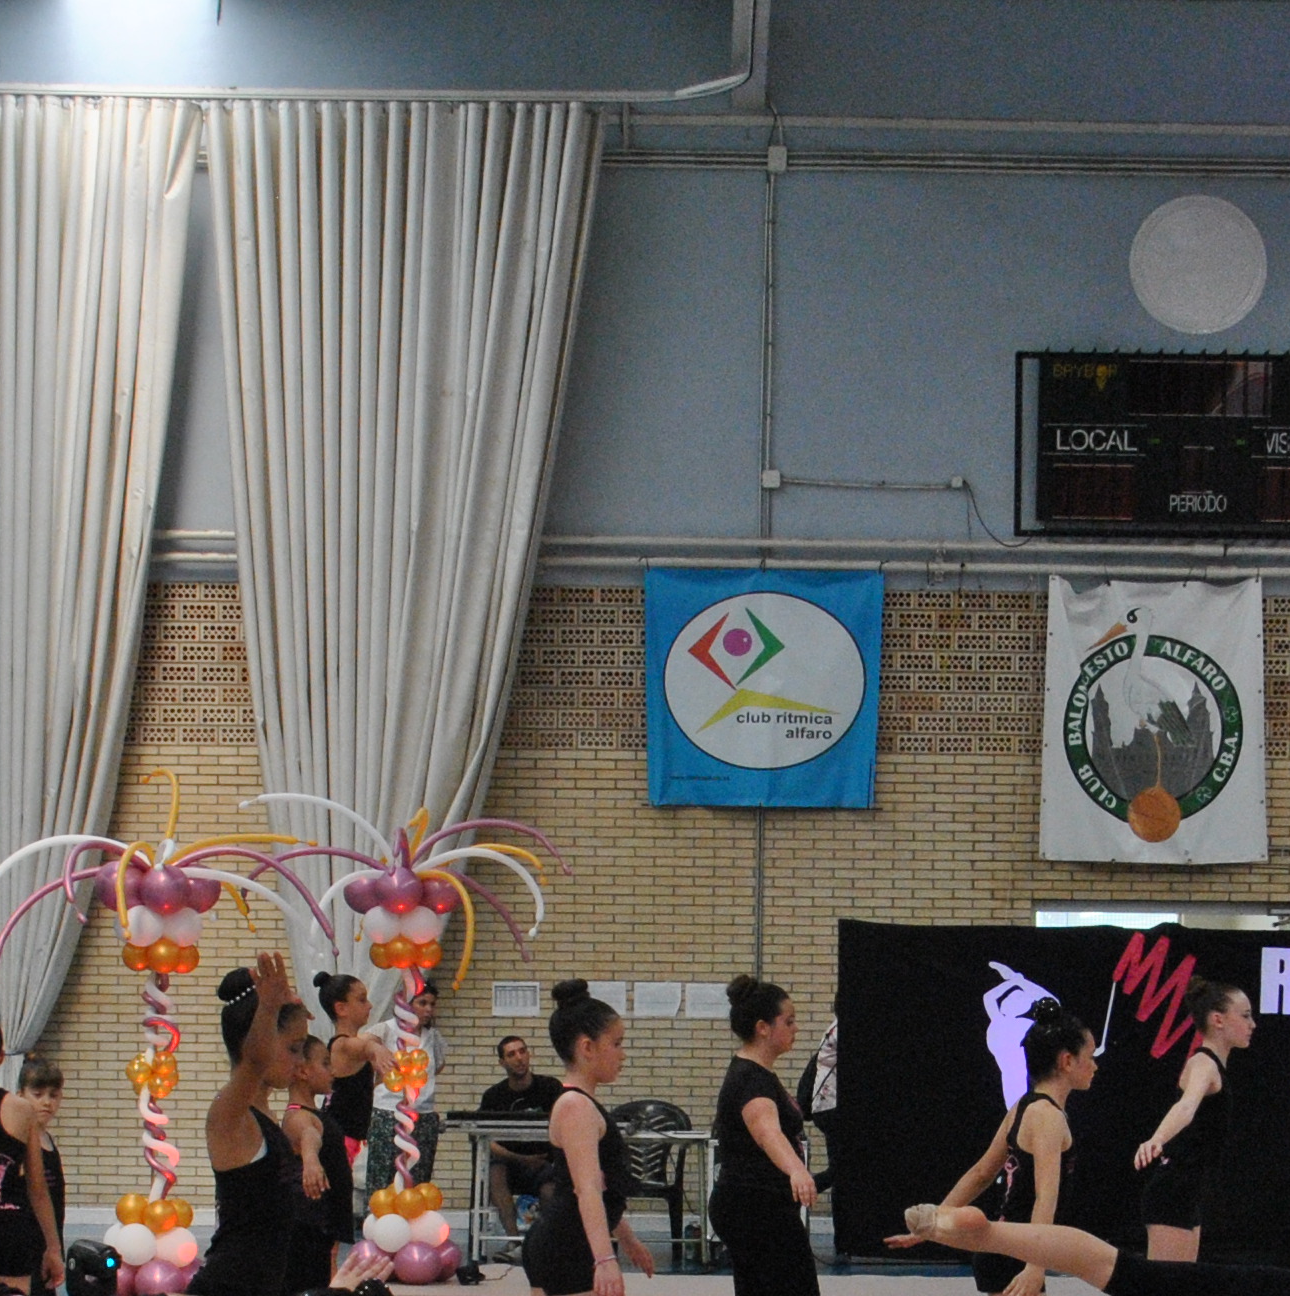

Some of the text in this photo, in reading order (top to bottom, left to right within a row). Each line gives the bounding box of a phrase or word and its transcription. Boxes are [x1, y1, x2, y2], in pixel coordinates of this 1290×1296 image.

[1056, 429, 1138, 452] LOCAL
[1169, 494, 1228, 513] PERIODO
[736, 711, 771, 724] club
[1078, 764, 1117, 809] CLUB
[1159, 640, 1227, 692] ALFARO
[785, 726, 833, 740] alfaro
